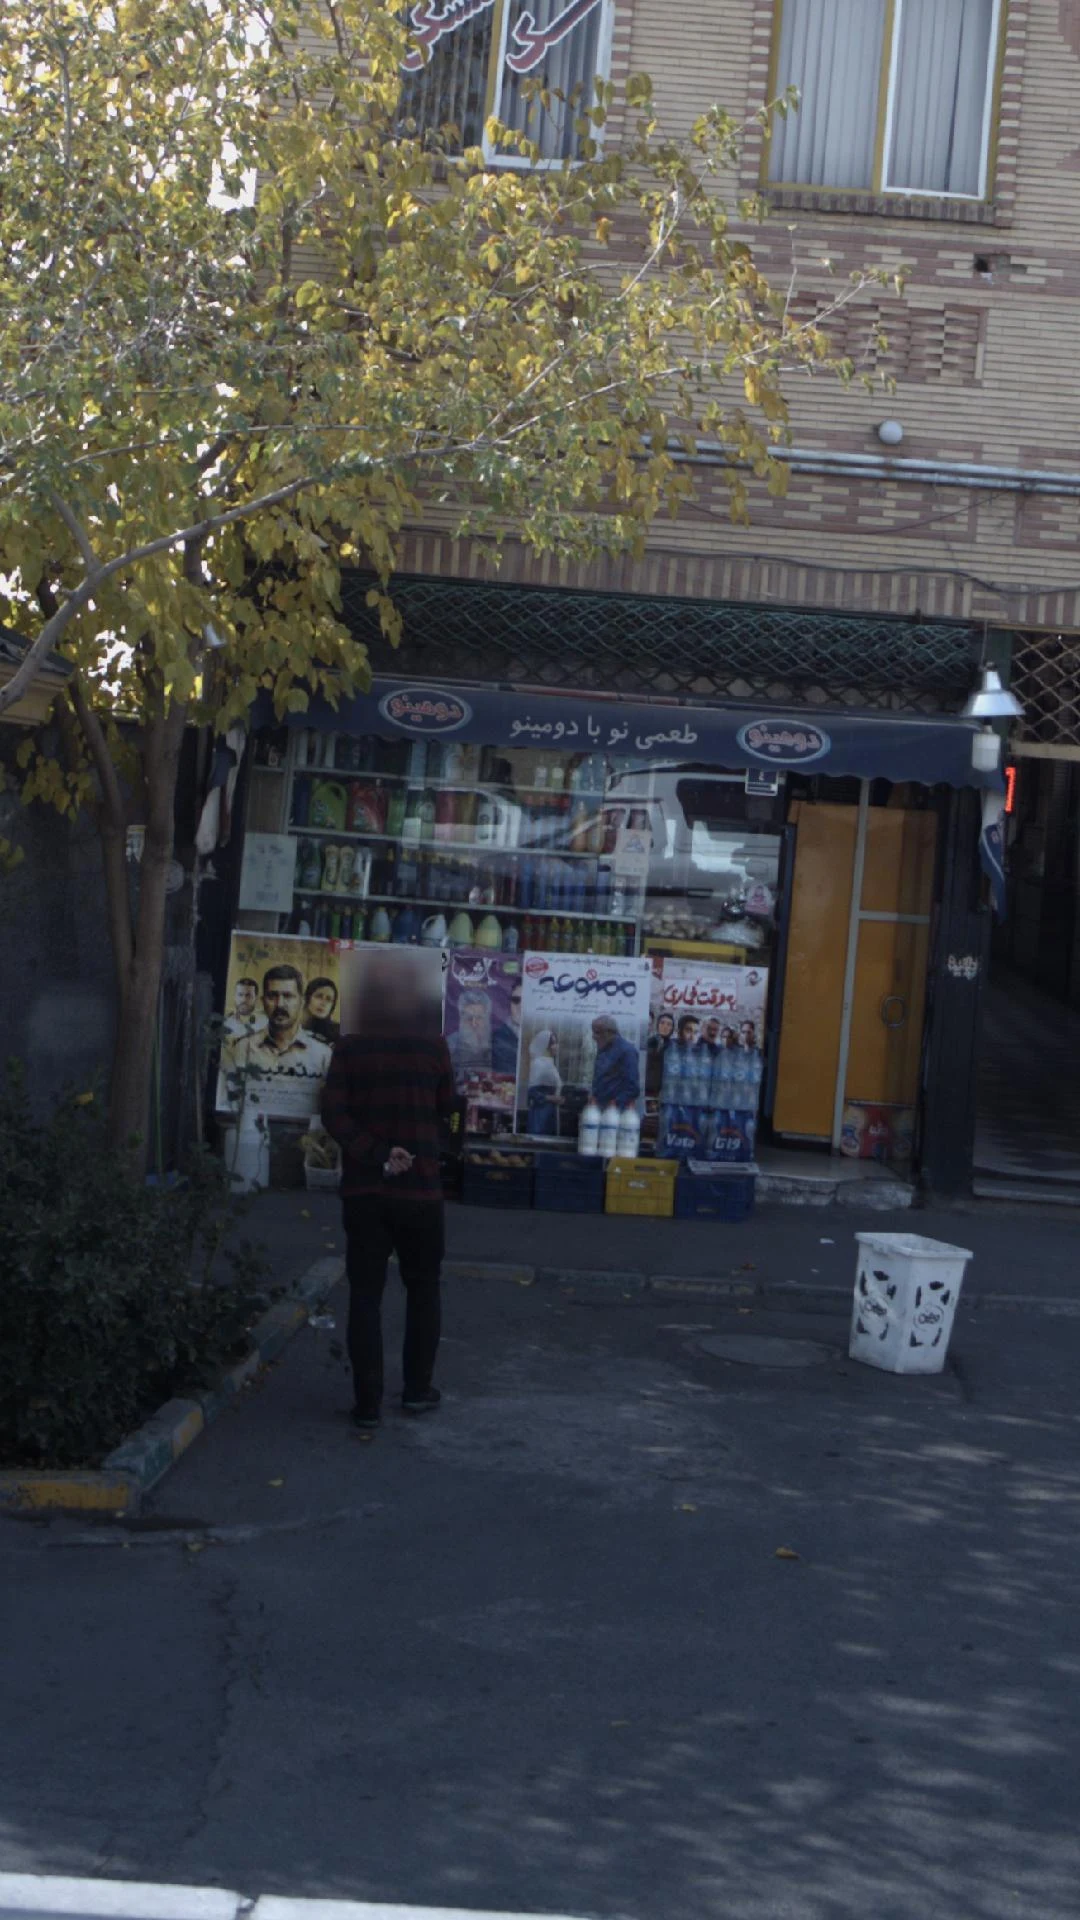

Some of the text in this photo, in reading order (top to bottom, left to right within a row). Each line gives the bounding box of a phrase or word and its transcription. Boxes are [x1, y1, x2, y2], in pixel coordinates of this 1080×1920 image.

[390, 695, 463, 721] دومینو
[509, 715, 698, 750] طعمی نو با دومینو
[748, 724, 821, 752] دومینو
